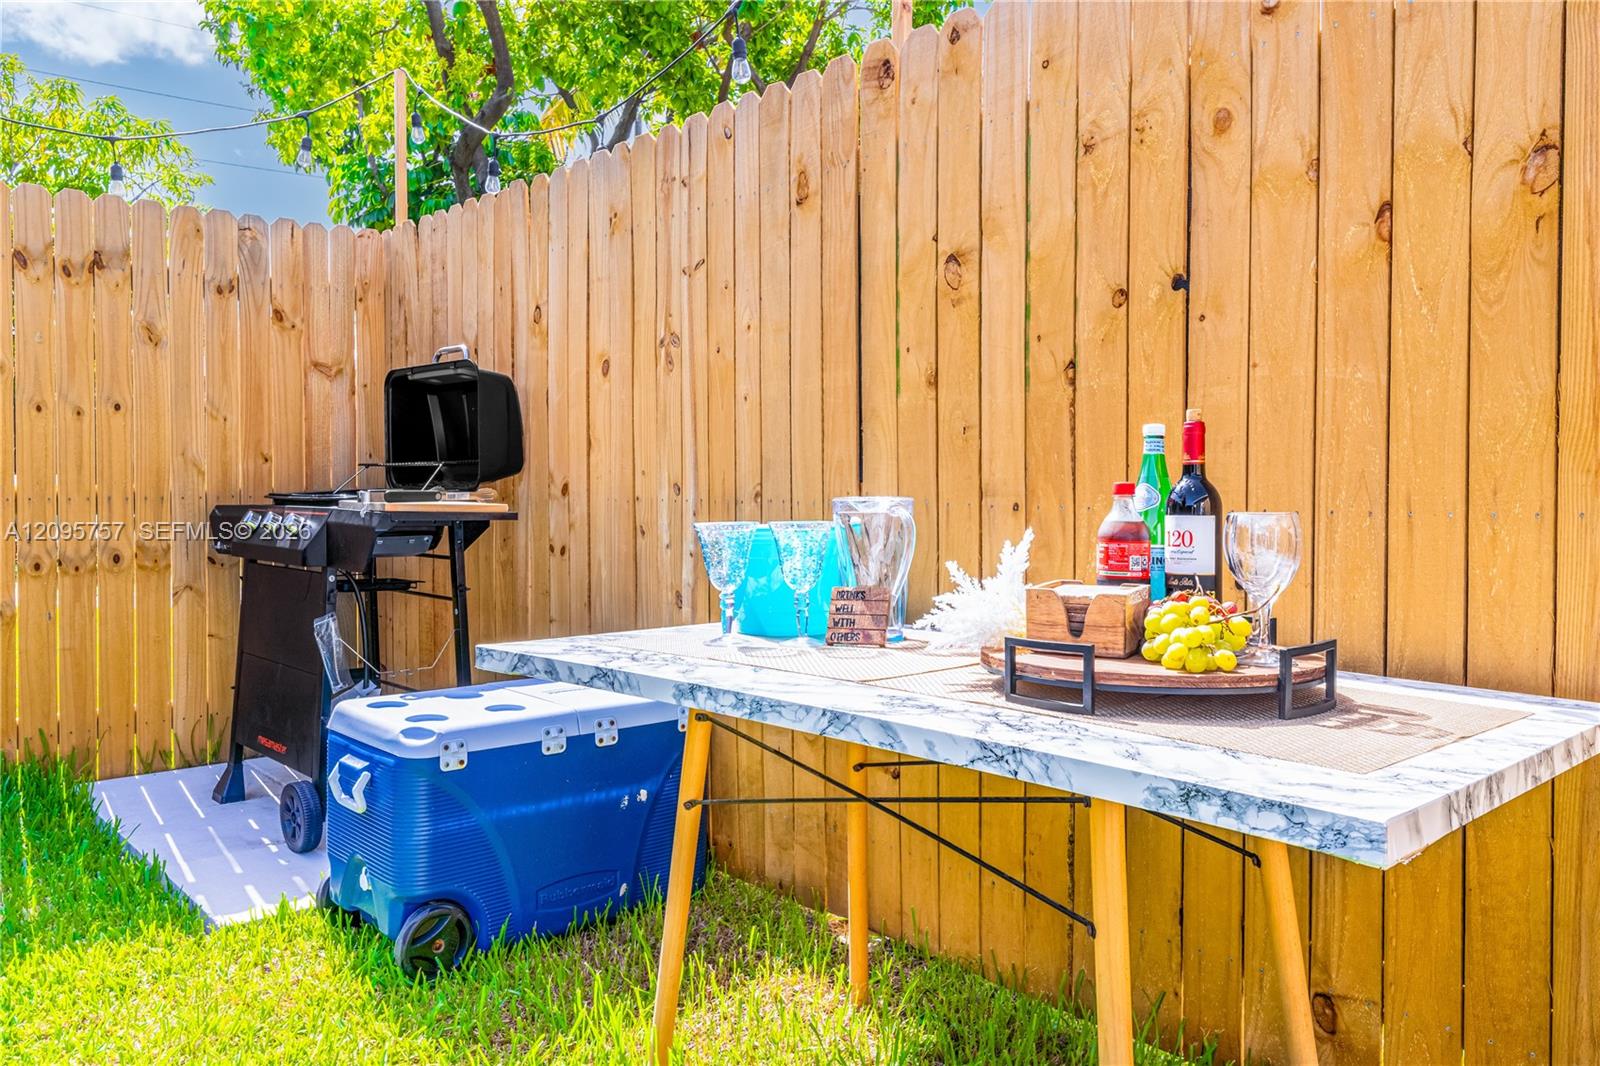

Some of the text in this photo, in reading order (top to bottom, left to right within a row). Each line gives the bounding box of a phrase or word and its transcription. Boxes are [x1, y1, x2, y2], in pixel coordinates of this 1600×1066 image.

[836, 590, 866, 600] DRINKS
[832, 617, 856, 627] WITH
[830, 632, 861, 642] OTHERS
